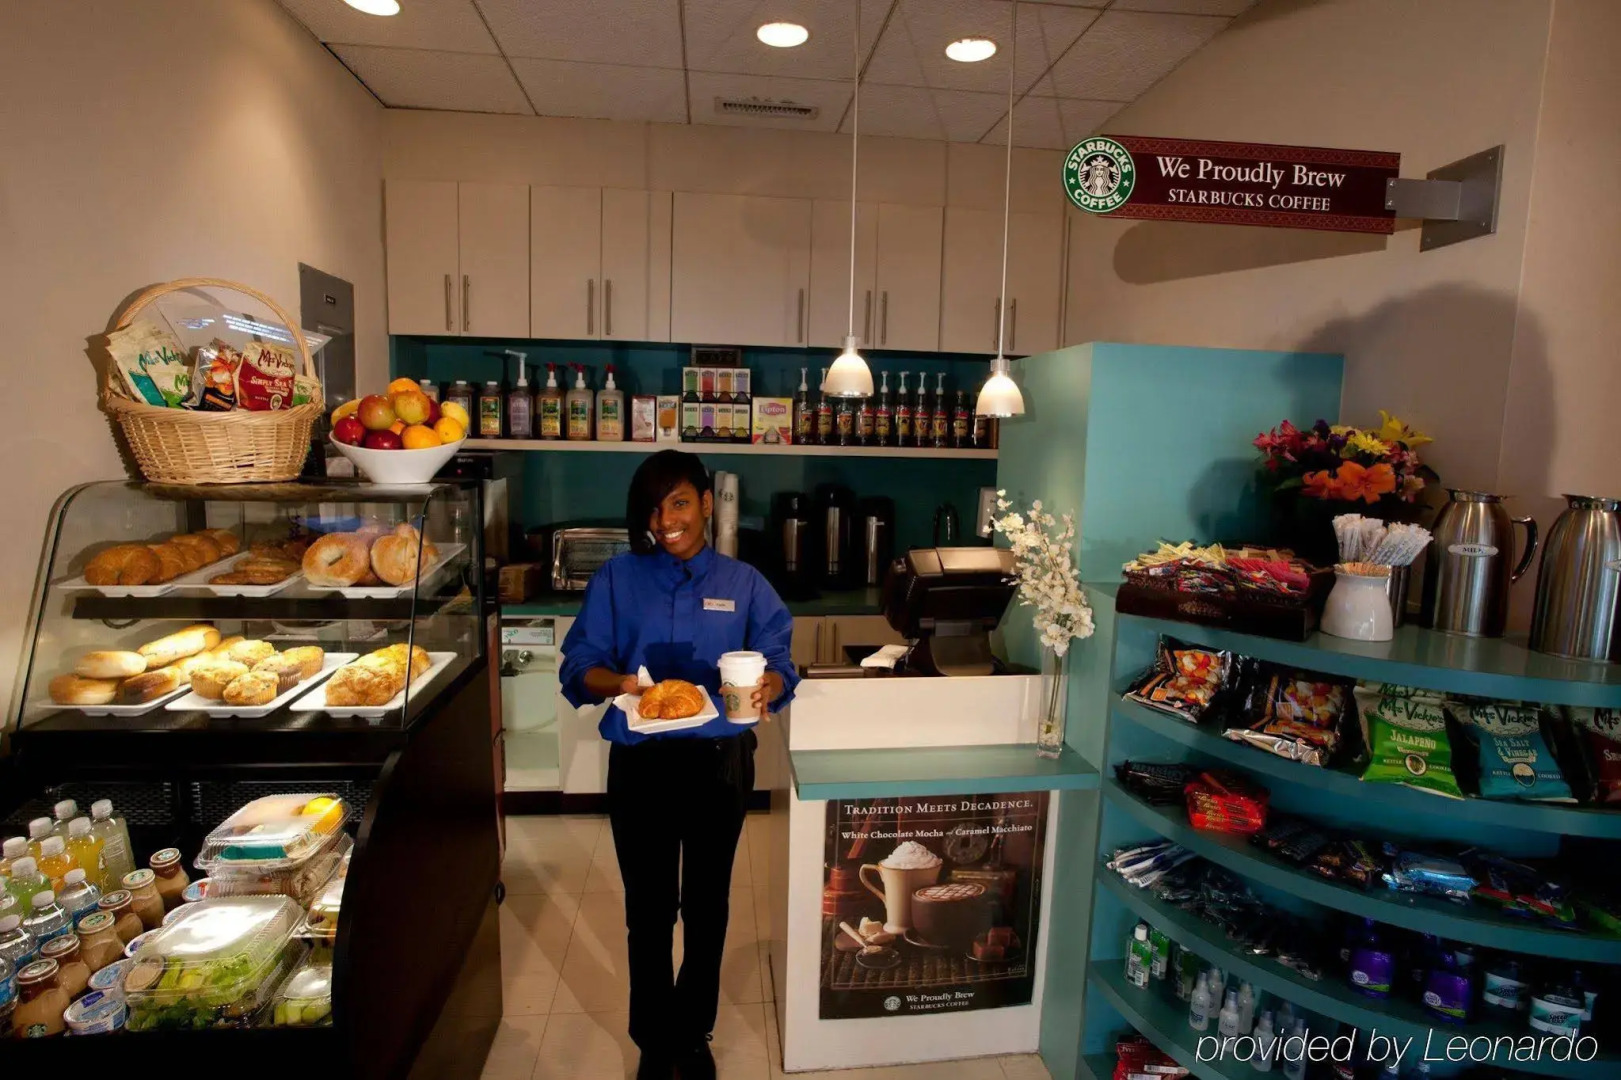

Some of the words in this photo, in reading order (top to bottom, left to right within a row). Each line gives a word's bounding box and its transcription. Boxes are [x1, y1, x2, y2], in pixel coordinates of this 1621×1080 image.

[1068, 141, 1132, 173] STARBUCKS
[1157, 156, 1190, 178] We
[1196, 158, 1285, 190] Proudly
[1291, 164, 1346, 188] Brew
[1074, 189, 1123, 209] COFFEE
[1168, 188, 1264, 208] STARBUCKS
[1268, 194, 1330, 212] COFFEE
[760, 404, 785, 415] Lipton
[844, 804, 913, 815] TRADITION
[916, 802, 957, 813] MEETS
[960, 799, 1033, 812] DECADENCE.
[841, 831, 869, 840] White
[870, 829, 914, 839] Chocolate
[915, 829, 943, 838] Mocha
[955, 826, 990, 836] Caramel
[991, 823, 1033, 834] Macchiato
[920, 993, 952, 1002] Proudly
[954, 991, 975, 999] Brew
